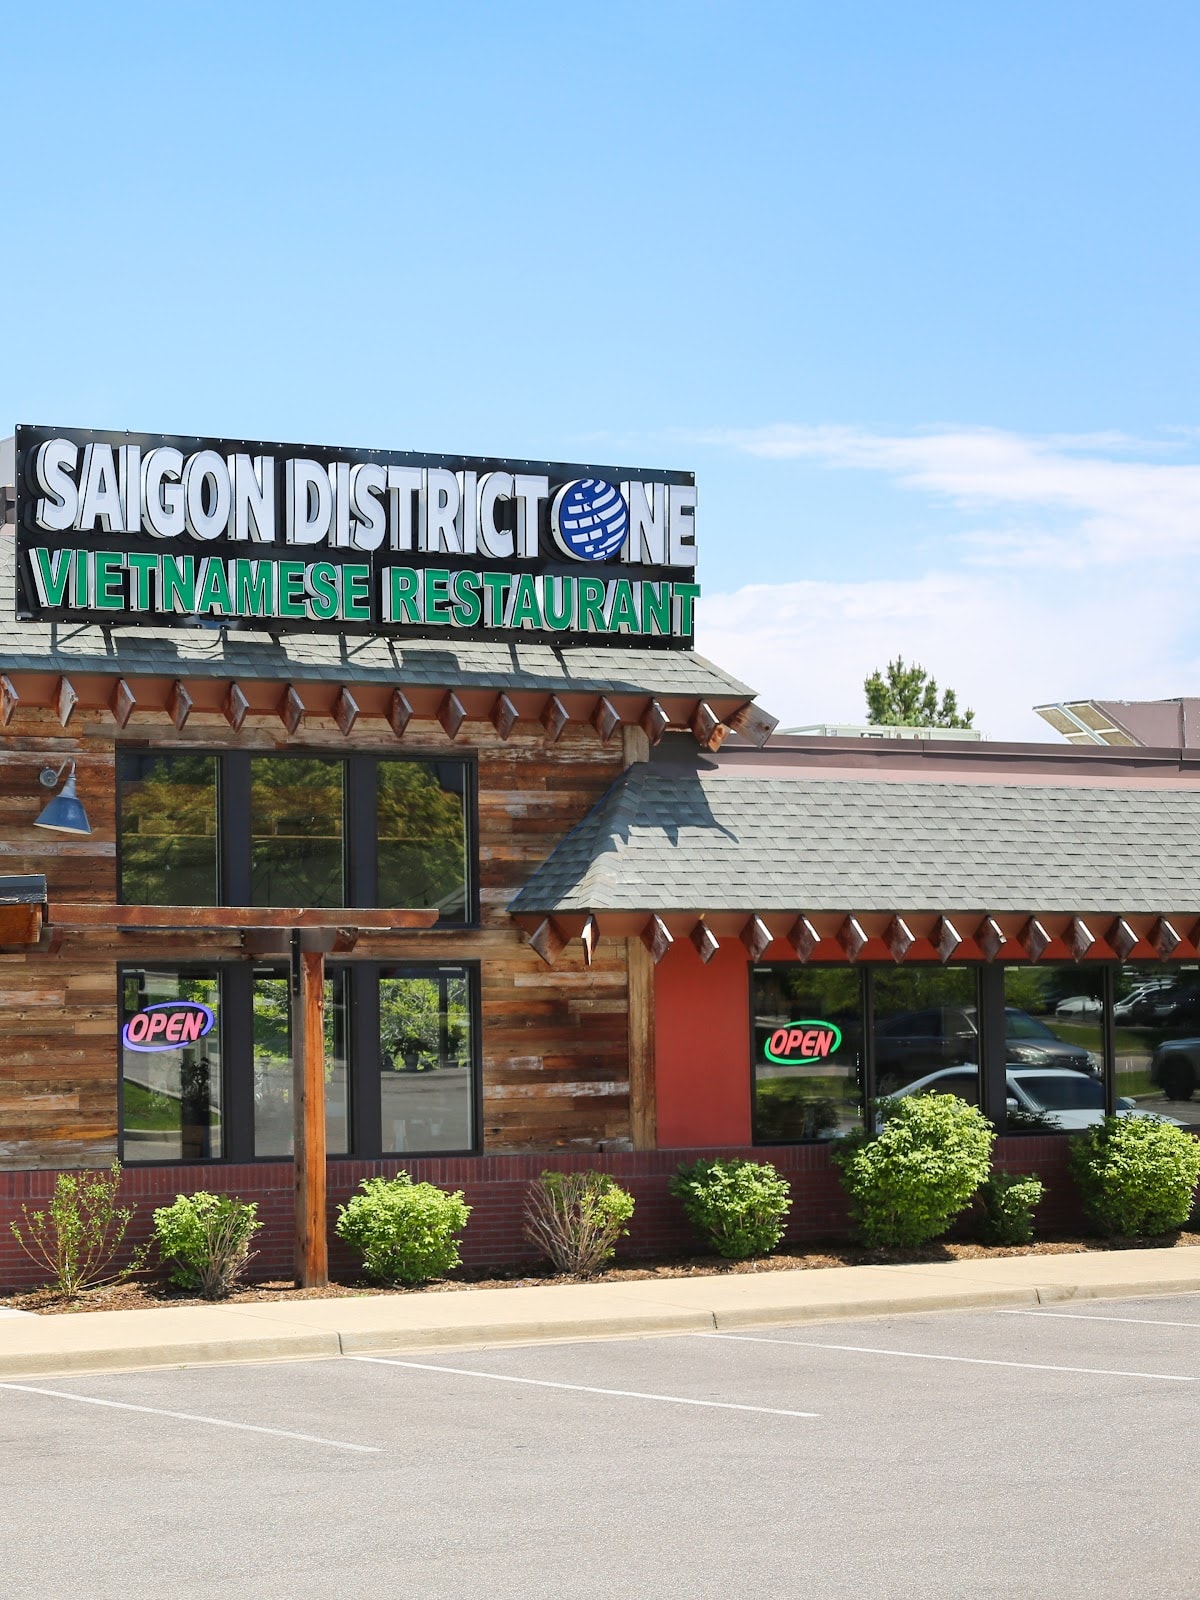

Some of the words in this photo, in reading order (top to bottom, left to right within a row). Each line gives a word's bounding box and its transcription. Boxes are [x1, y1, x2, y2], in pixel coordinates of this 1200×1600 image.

[36, 438, 275, 542] SAIGON
[286, 458, 549, 559] DISTRICT
[28, 547, 371, 621] VIETNAMESE
[382, 566, 701, 637] RESTAURANT
[128, 1012, 204, 1042] OPEN
[770, 1029, 833, 1056] OPEN
